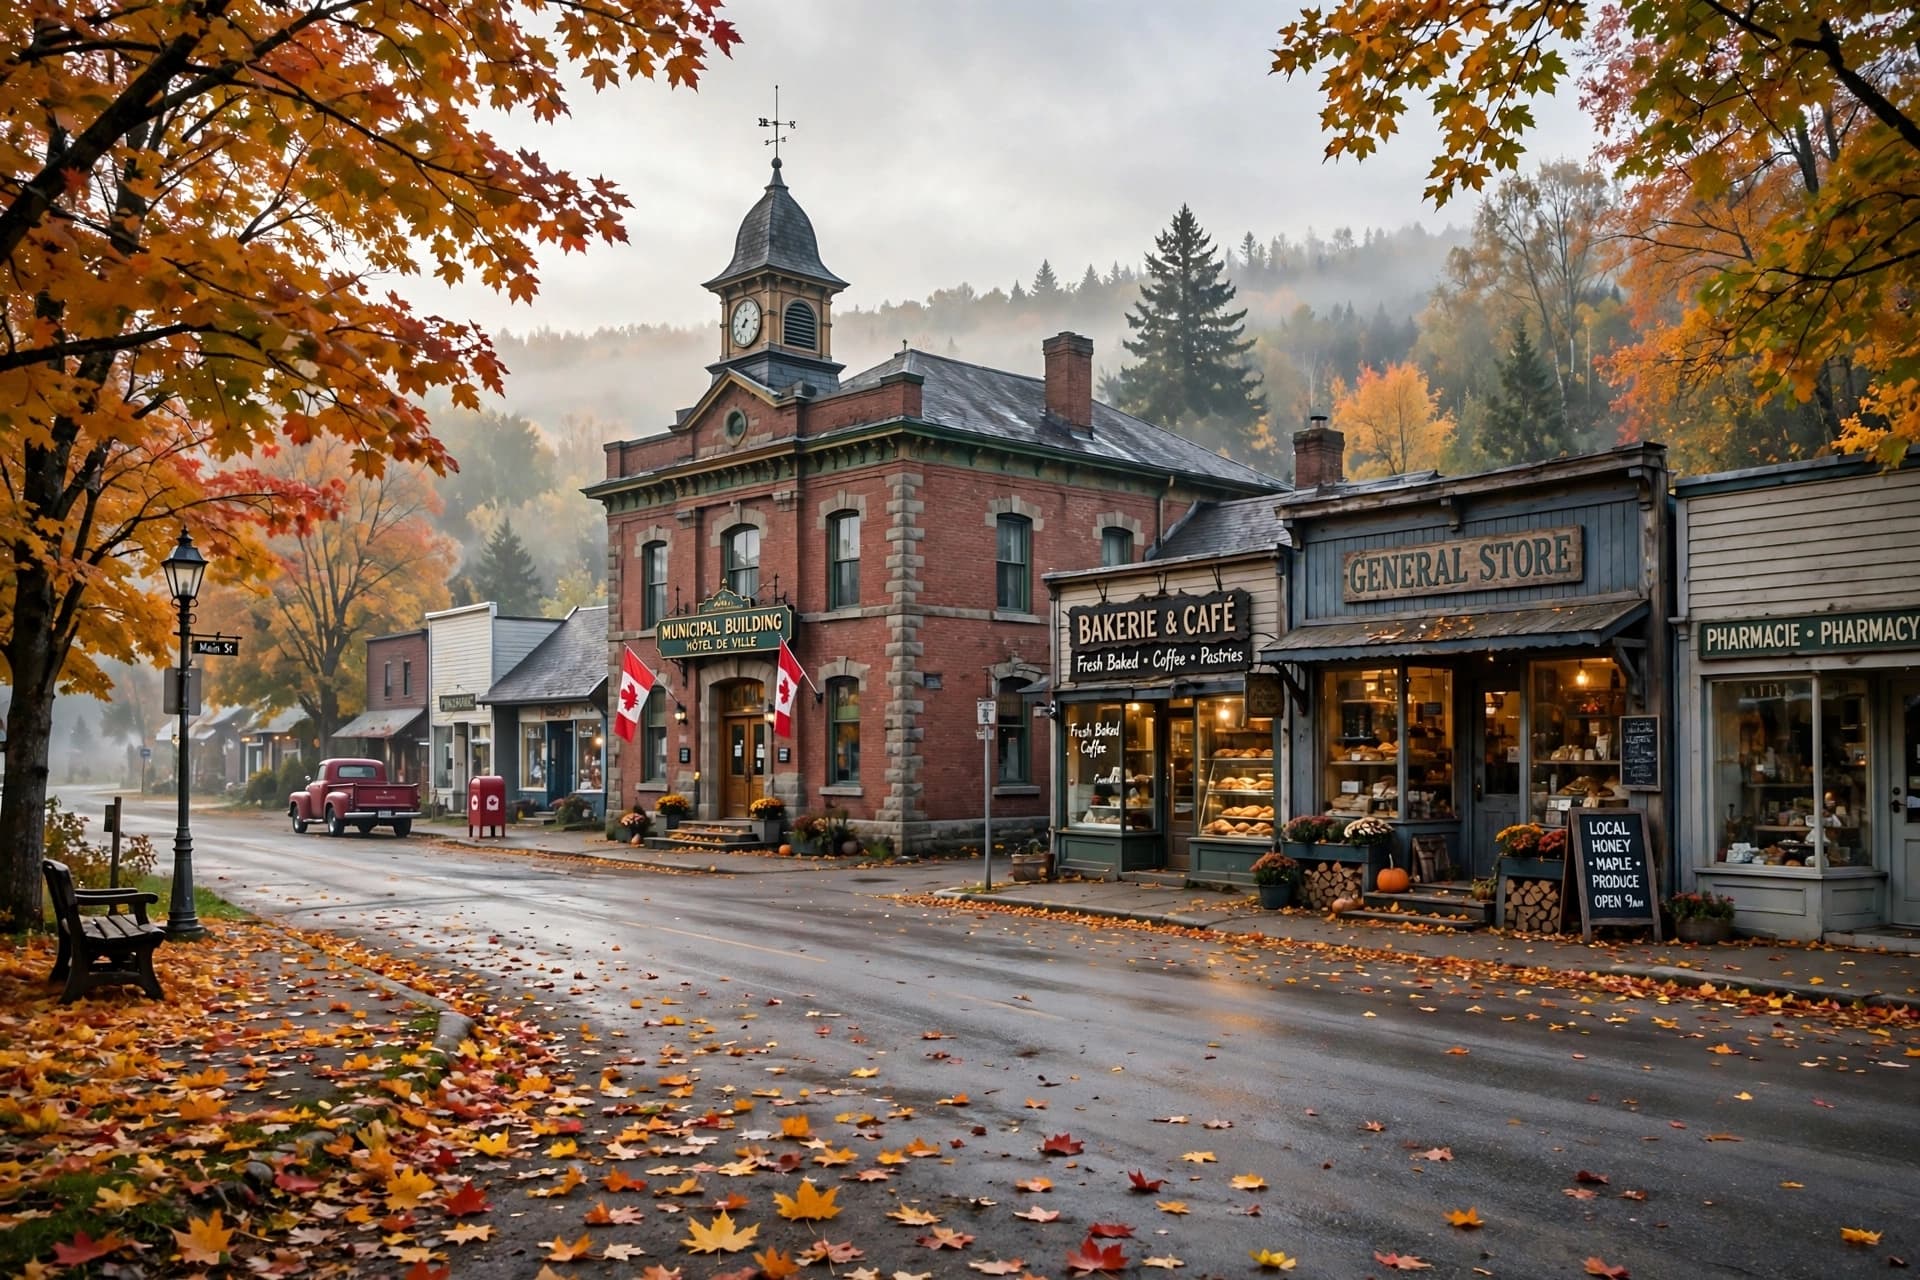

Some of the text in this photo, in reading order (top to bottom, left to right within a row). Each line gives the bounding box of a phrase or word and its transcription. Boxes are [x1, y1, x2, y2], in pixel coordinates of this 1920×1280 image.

[1350, 535, 1571, 593] GENERAL STORE
[662, 613, 782, 640] MUNICIPAL BUILDING
[1078, 595, 1236, 645] BAKERIE & CAFÉ
[1707, 616, 1920, 651] PHARMACIE PHARMACY
[686, 636, 757, 651] HÔTEL DE VILLE
[1077, 647, 1243, 672] Fresh Baked Coffee Pastries
[1071, 721, 1120, 737] Fresh Baked
[1081, 739, 1107, 758] Coffee
[1589, 821, 1630, 835] LOCAL
[1592, 839, 1631, 853] HONEY
[1596, 857, 1632, 871] MAPLE
[1592, 875, 1640, 888] PRODUCE
[1594, 894, 1621, 908] OPEN
